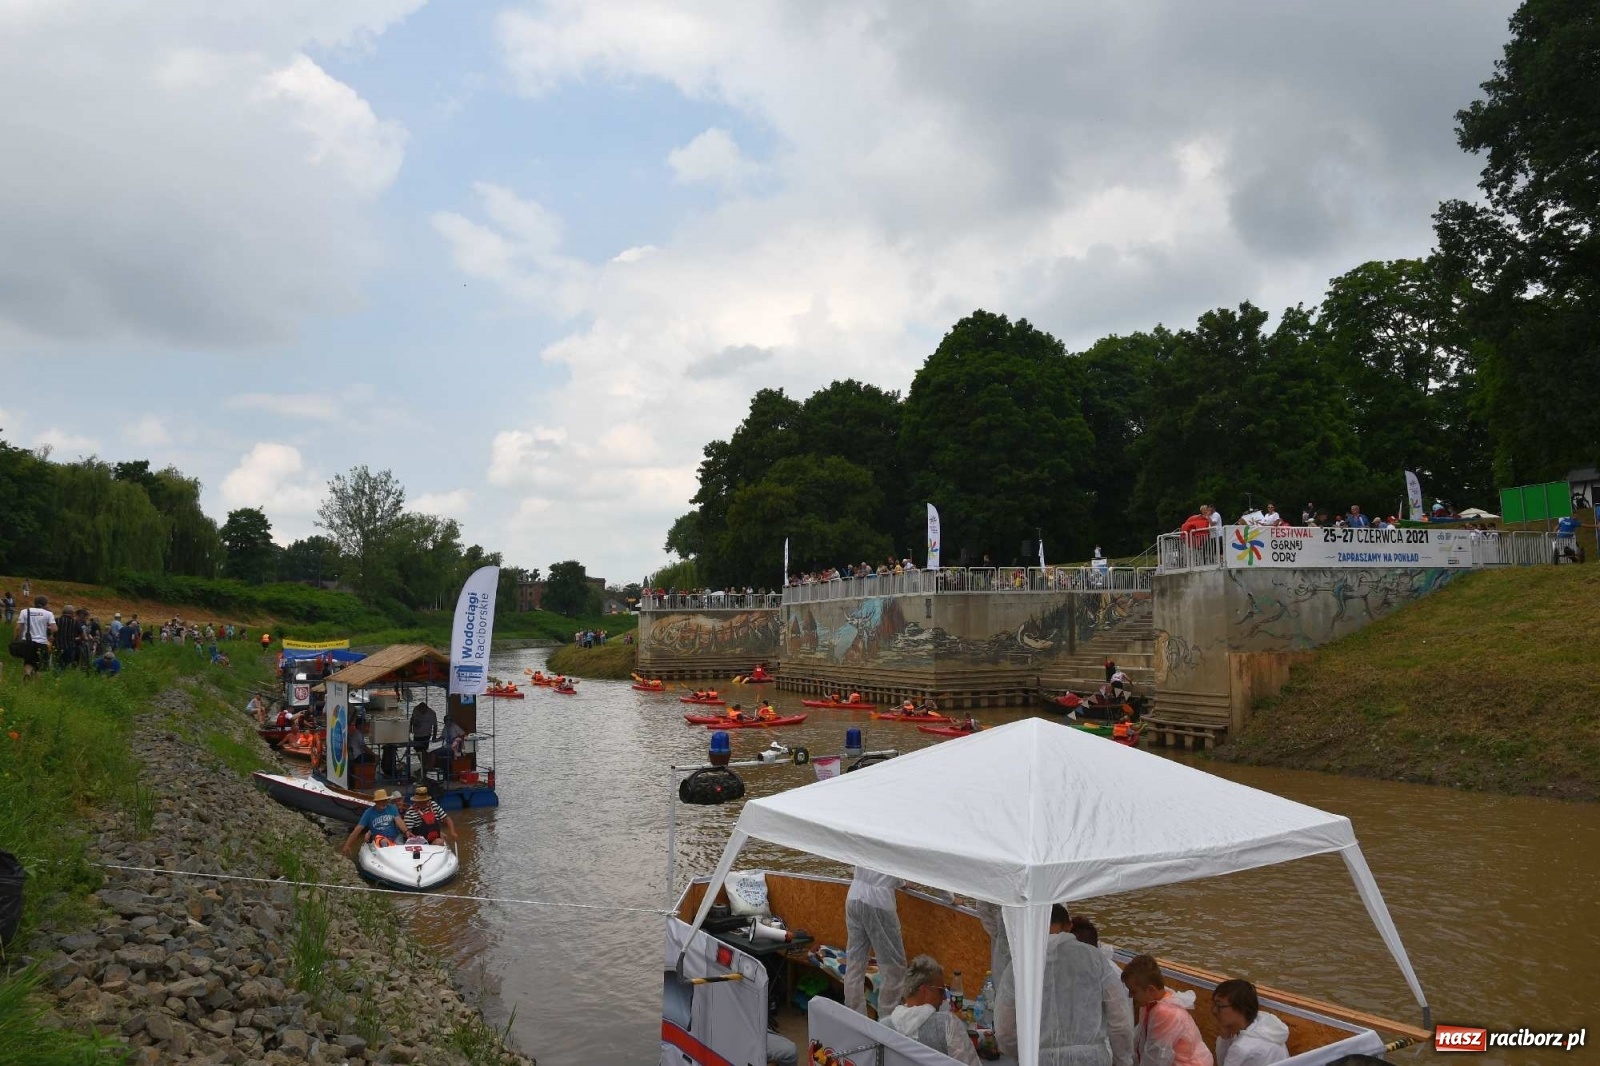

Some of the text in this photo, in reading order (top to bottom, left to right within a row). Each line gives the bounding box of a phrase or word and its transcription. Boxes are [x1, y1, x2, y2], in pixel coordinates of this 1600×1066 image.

[1270, 528, 1313, 538] FESTIWAL
[1323, 528, 1354, 543] 25-27
[1357, 529, 1404, 544] CZERWCA
[1406, 530, 1429, 544] 2021
[1270, 540, 1303, 551] GÓRNEJ
[1271, 552, 1296, 563] ODRY
[1338, 552, 1419, 562] ZAPRASZAMY NA POKŁAD
[462, 592, 479, 659] Wodociągi
[475, 593, 489, 659] Raciborskie
